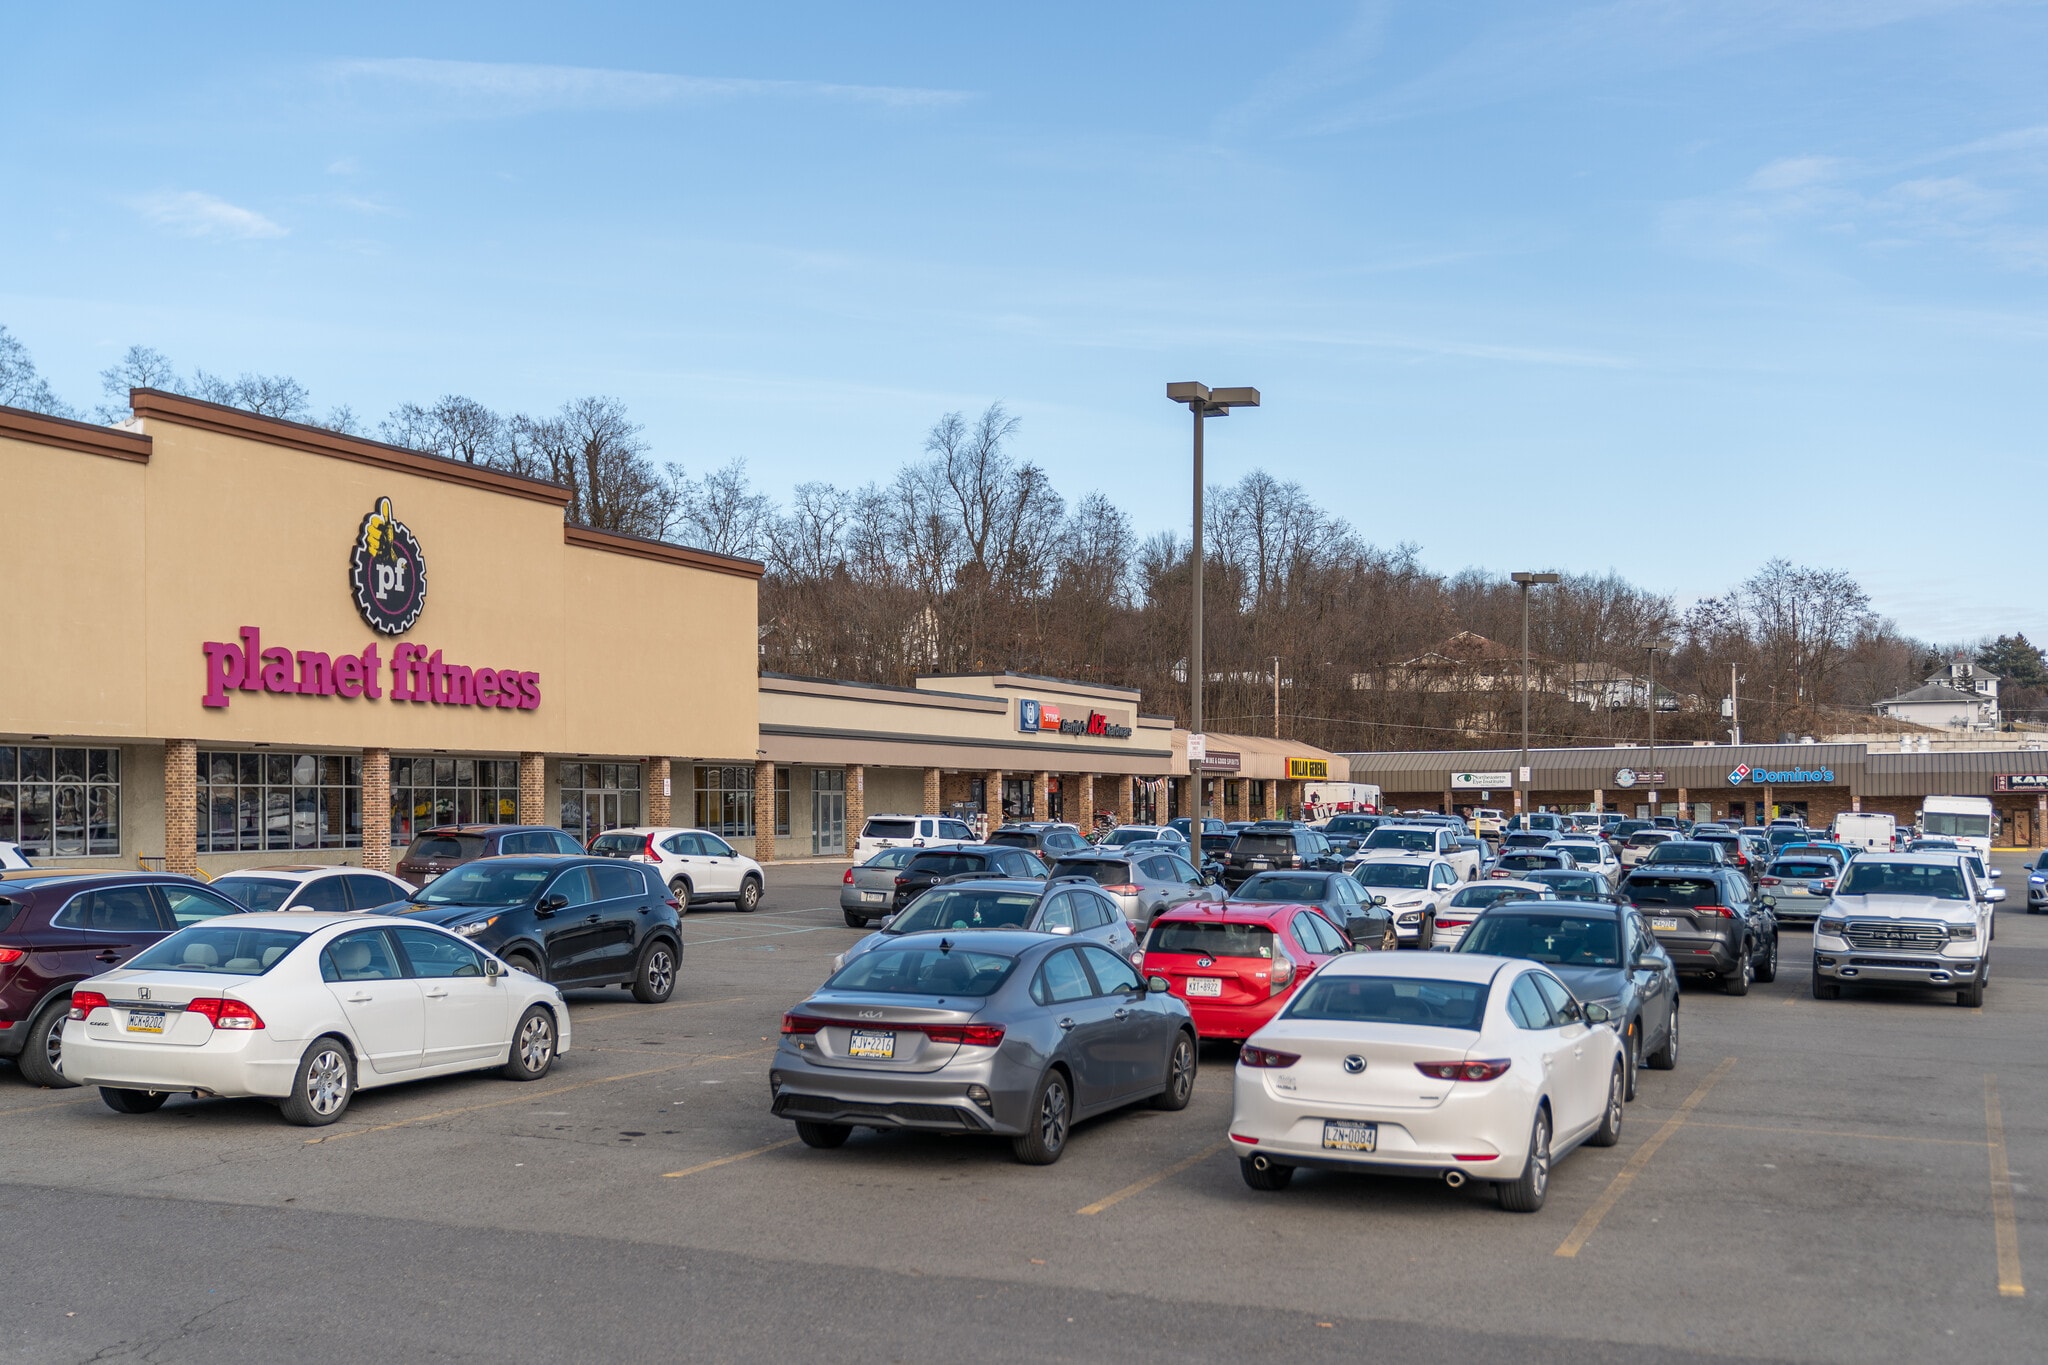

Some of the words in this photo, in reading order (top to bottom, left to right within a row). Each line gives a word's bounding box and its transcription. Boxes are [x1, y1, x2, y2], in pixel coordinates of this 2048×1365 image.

[376, 557, 408, 600] pf
[203, 626, 382, 707] planet
[390, 642, 541, 710] fitness
[1088, 709, 1107, 735] ACE
[1291, 760, 1309, 777] DOLLAR
[1309, 761, 1328, 778] GENERAL
[1752, 765, 1835, 783] Domino's
[1874, 931, 1915, 940] RAM
